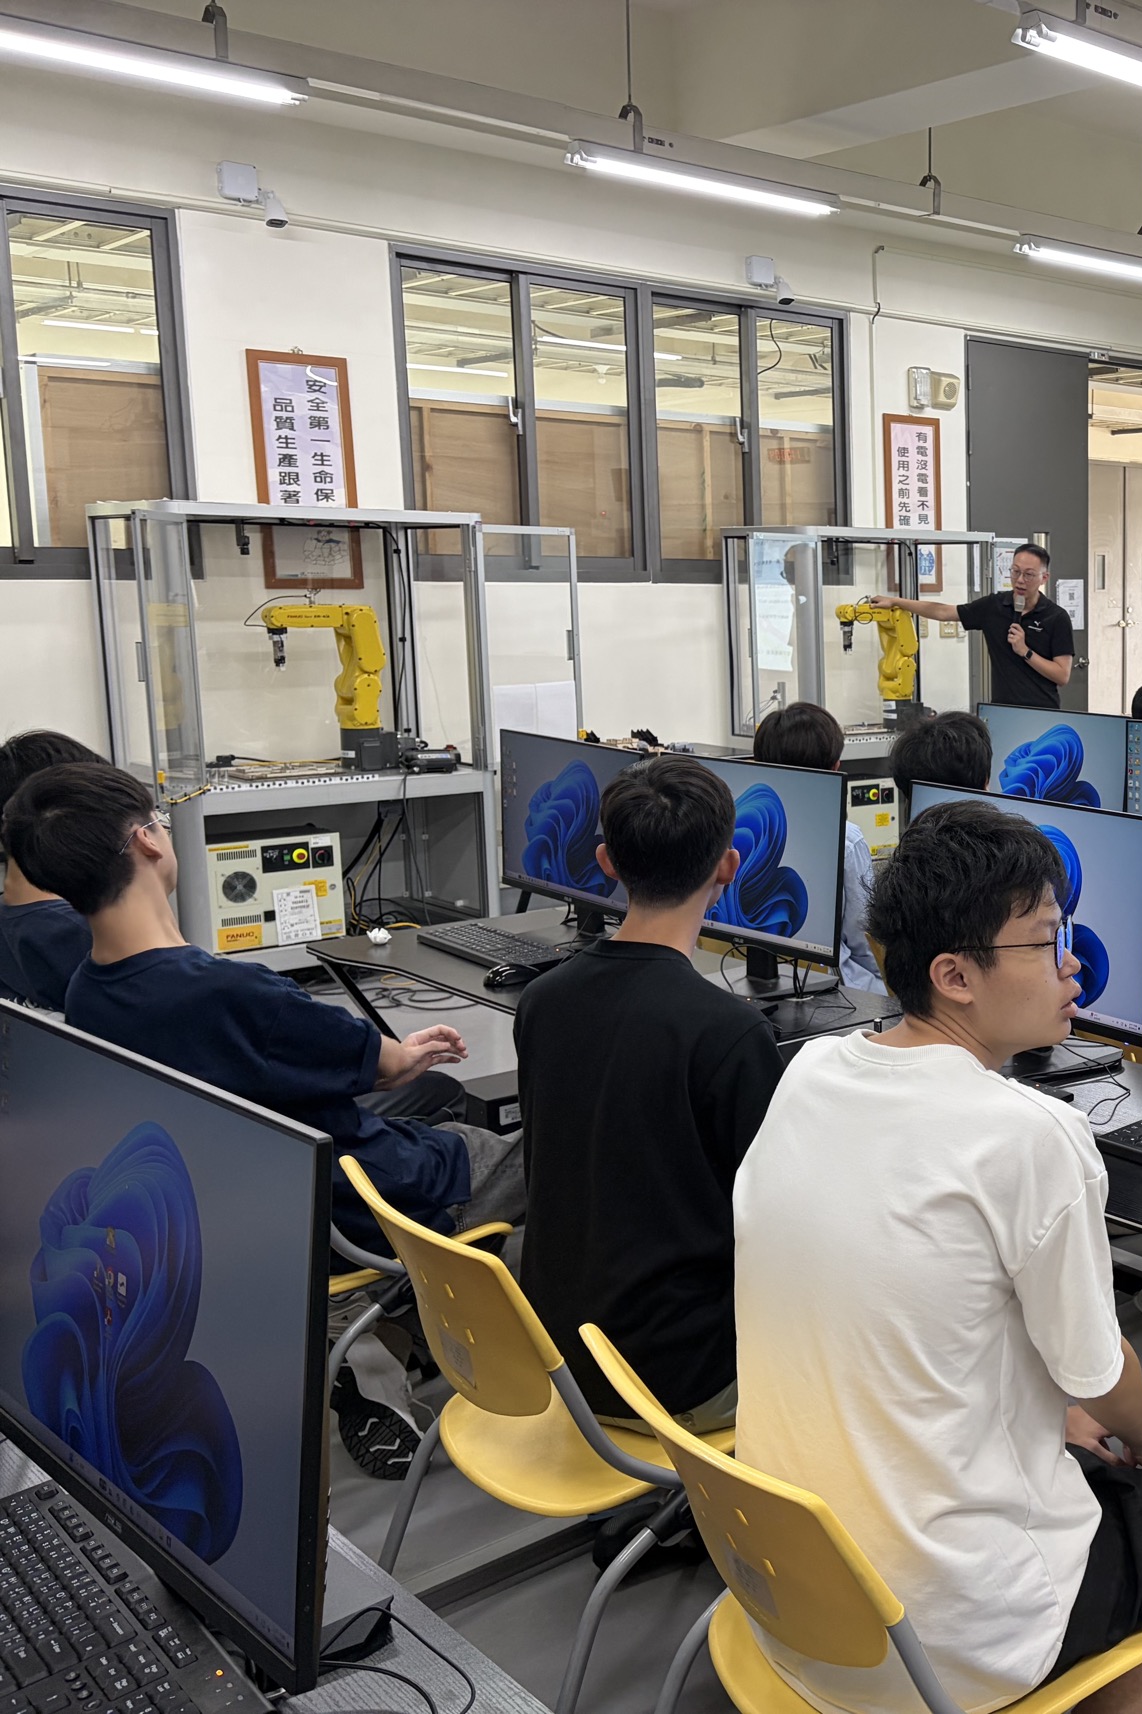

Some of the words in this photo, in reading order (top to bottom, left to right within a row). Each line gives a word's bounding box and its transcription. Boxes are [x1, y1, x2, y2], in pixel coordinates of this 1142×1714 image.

[305, 378, 335, 502] 安全第一生命保
[915, 432, 930, 525] 有電沒電看不見
[896, 446, 911, 527] 使用之前先確
[226, 931, 255, 940] FANUC
